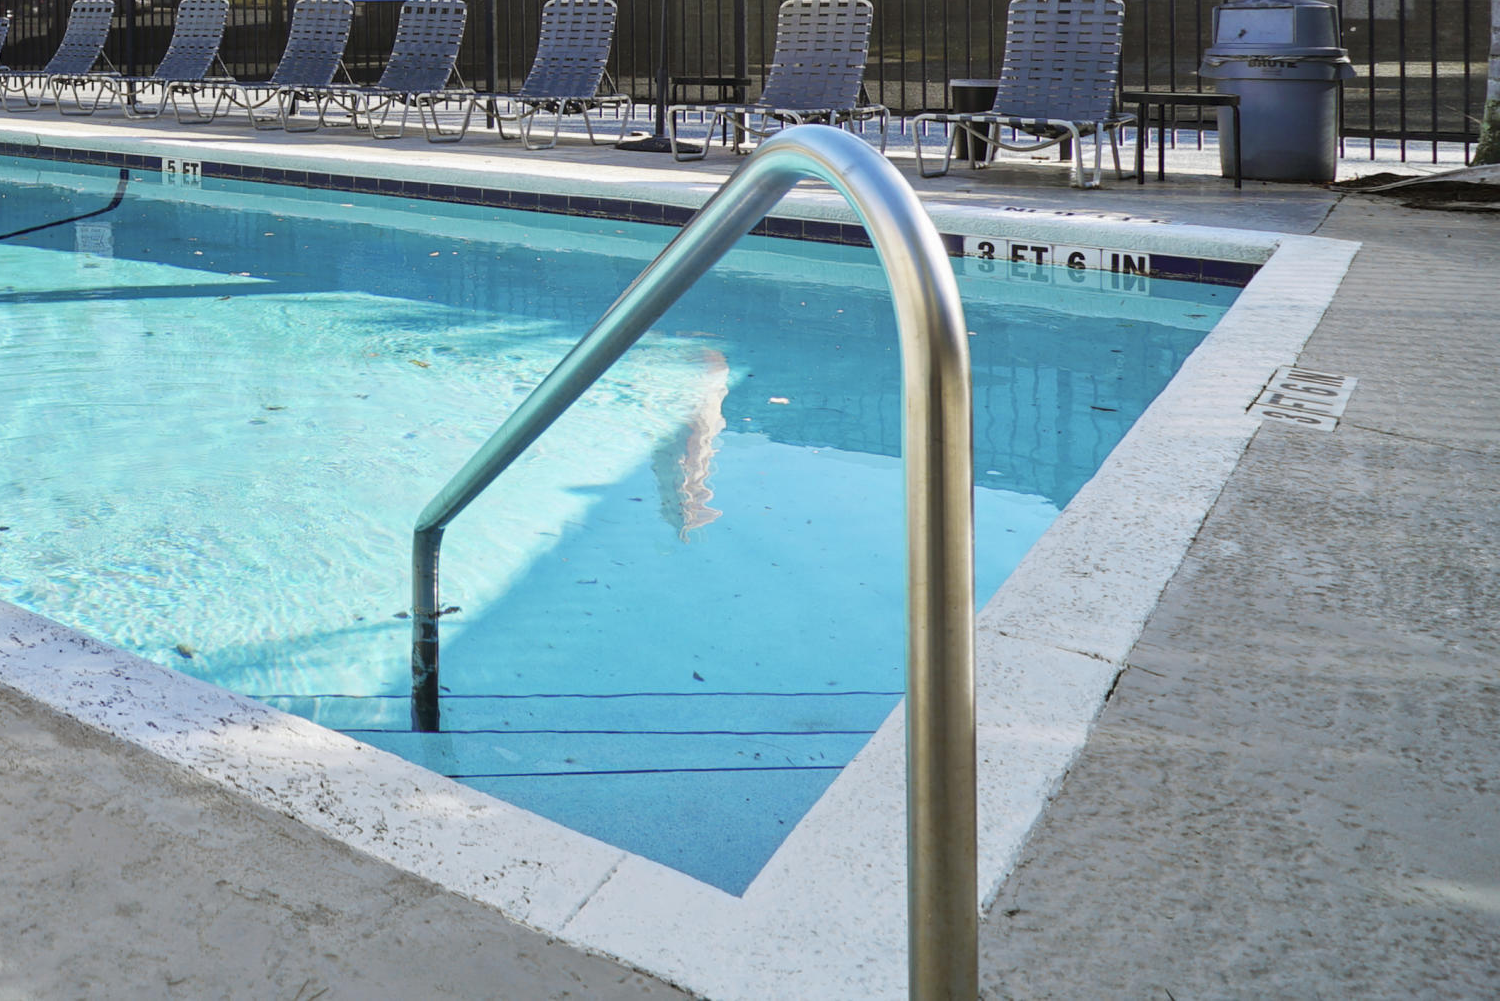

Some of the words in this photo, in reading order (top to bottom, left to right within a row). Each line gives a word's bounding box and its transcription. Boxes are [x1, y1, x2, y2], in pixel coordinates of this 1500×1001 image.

[167, 160, 176, 173] 5
[182, 162, 199, 175] FT
[977, 241, 996, 260] 3
[1011, 244, 1049, 265] FT
[1067, 251, 1086, 270] 6
[1111, 253, 1147, 276] IN
[1279, 383, 1339, 397] 6
[1268, 393, 1334, 414] FT
[1262, 410, 1322, 425] 3
